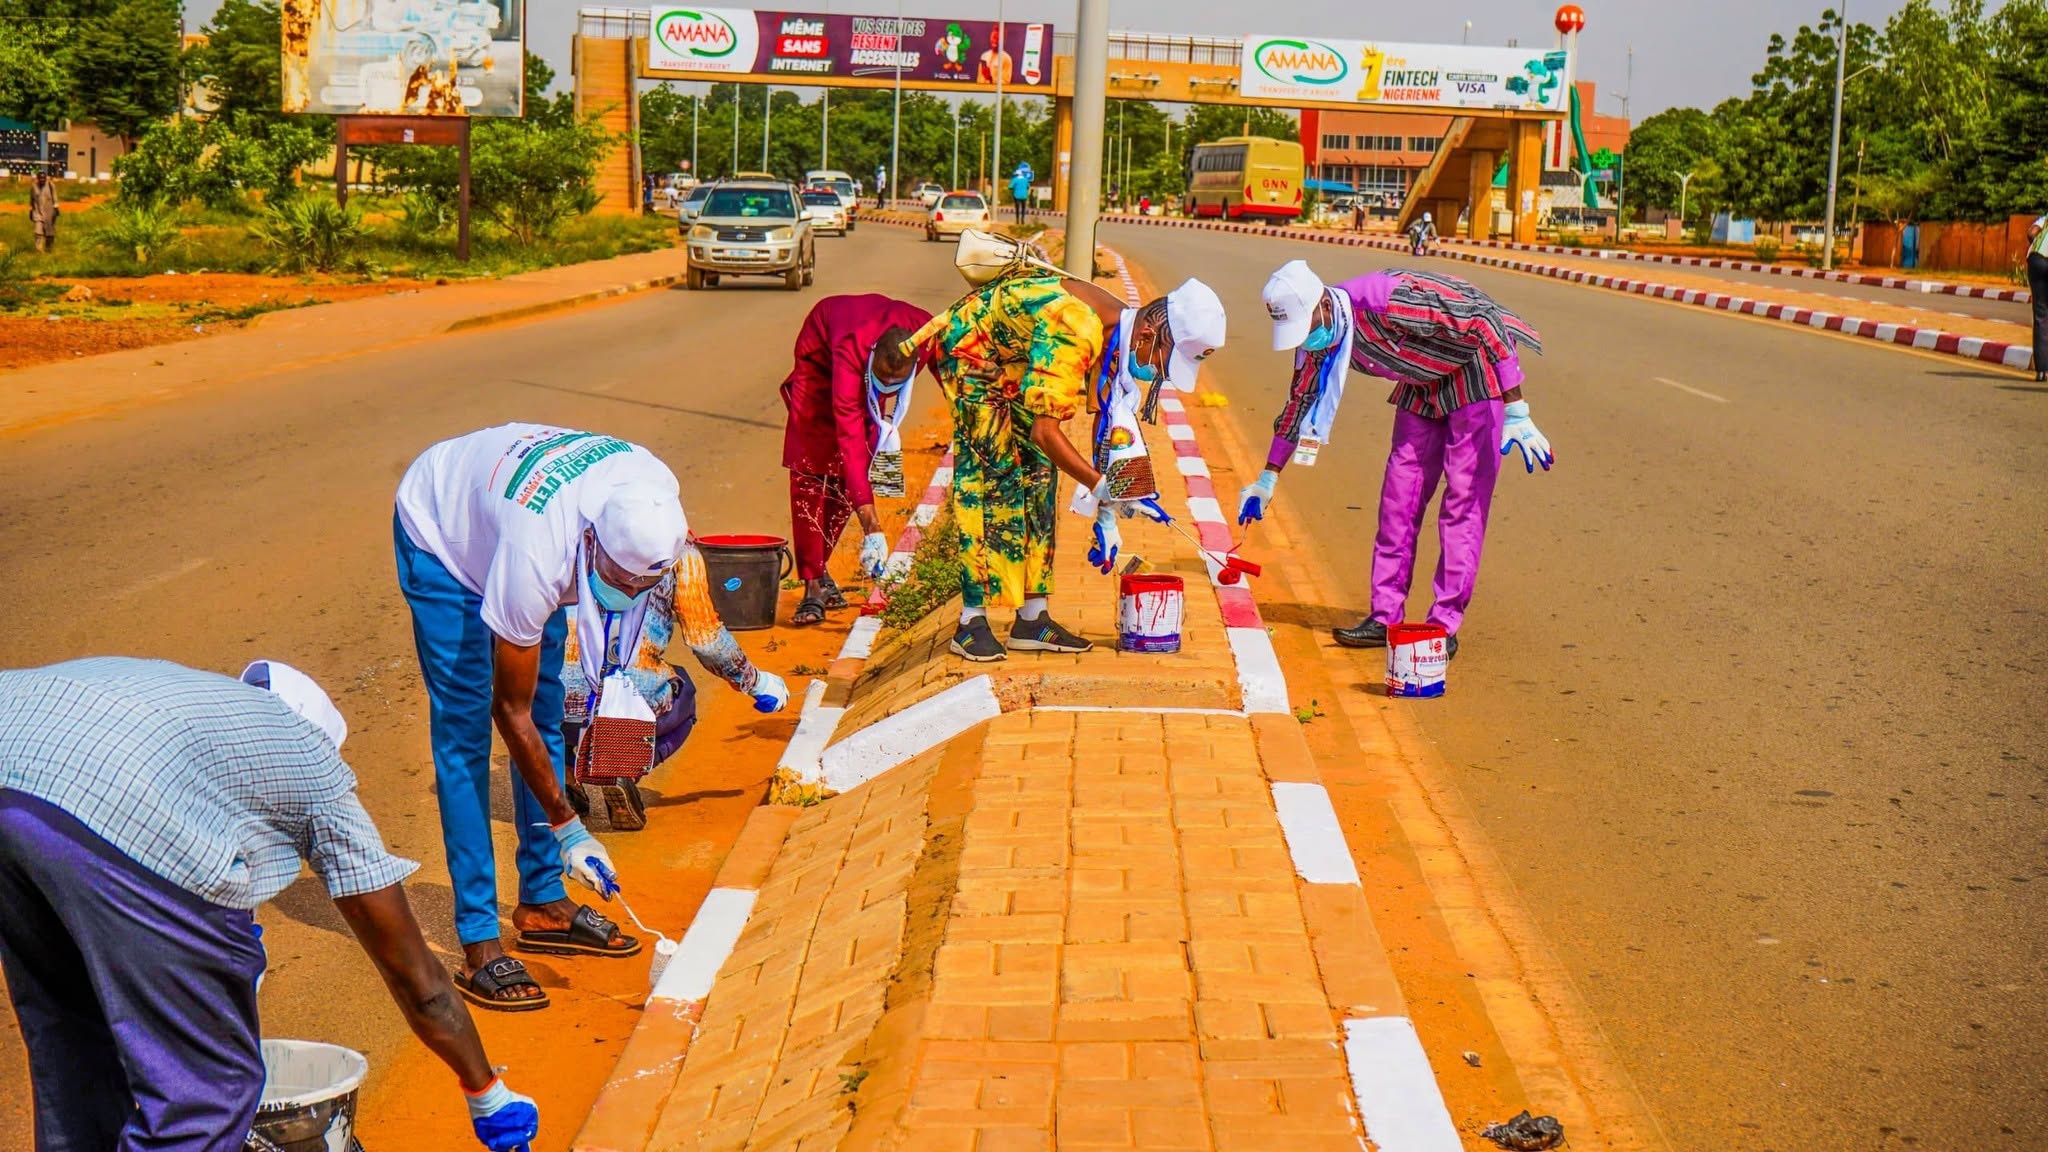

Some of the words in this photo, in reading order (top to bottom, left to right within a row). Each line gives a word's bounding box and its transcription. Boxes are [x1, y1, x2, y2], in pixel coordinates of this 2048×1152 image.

[665, 22, 730, 43] AMANA
[781, 18, 824, 36] MÊME
[852, 18, 875, 34] VOS
[782, 38, 822, 54] SANS
[850, 34, 897, 51] RESTENT
[771, 57, 832, 72] INTERNET
[1265, 50, 1339, 71] AMANA
[1383, 70, 1440, 86] FINTECH
[1382, 88, 1441, 101] NIGERIENNE
[1457, 82, 1486, 94] VISA
[1262, 179, 1288, 189] GNN
[555, 440, 633, 485] UNIVERSITÉ
[525, 475, 563, 515] D'ÉTÉ
